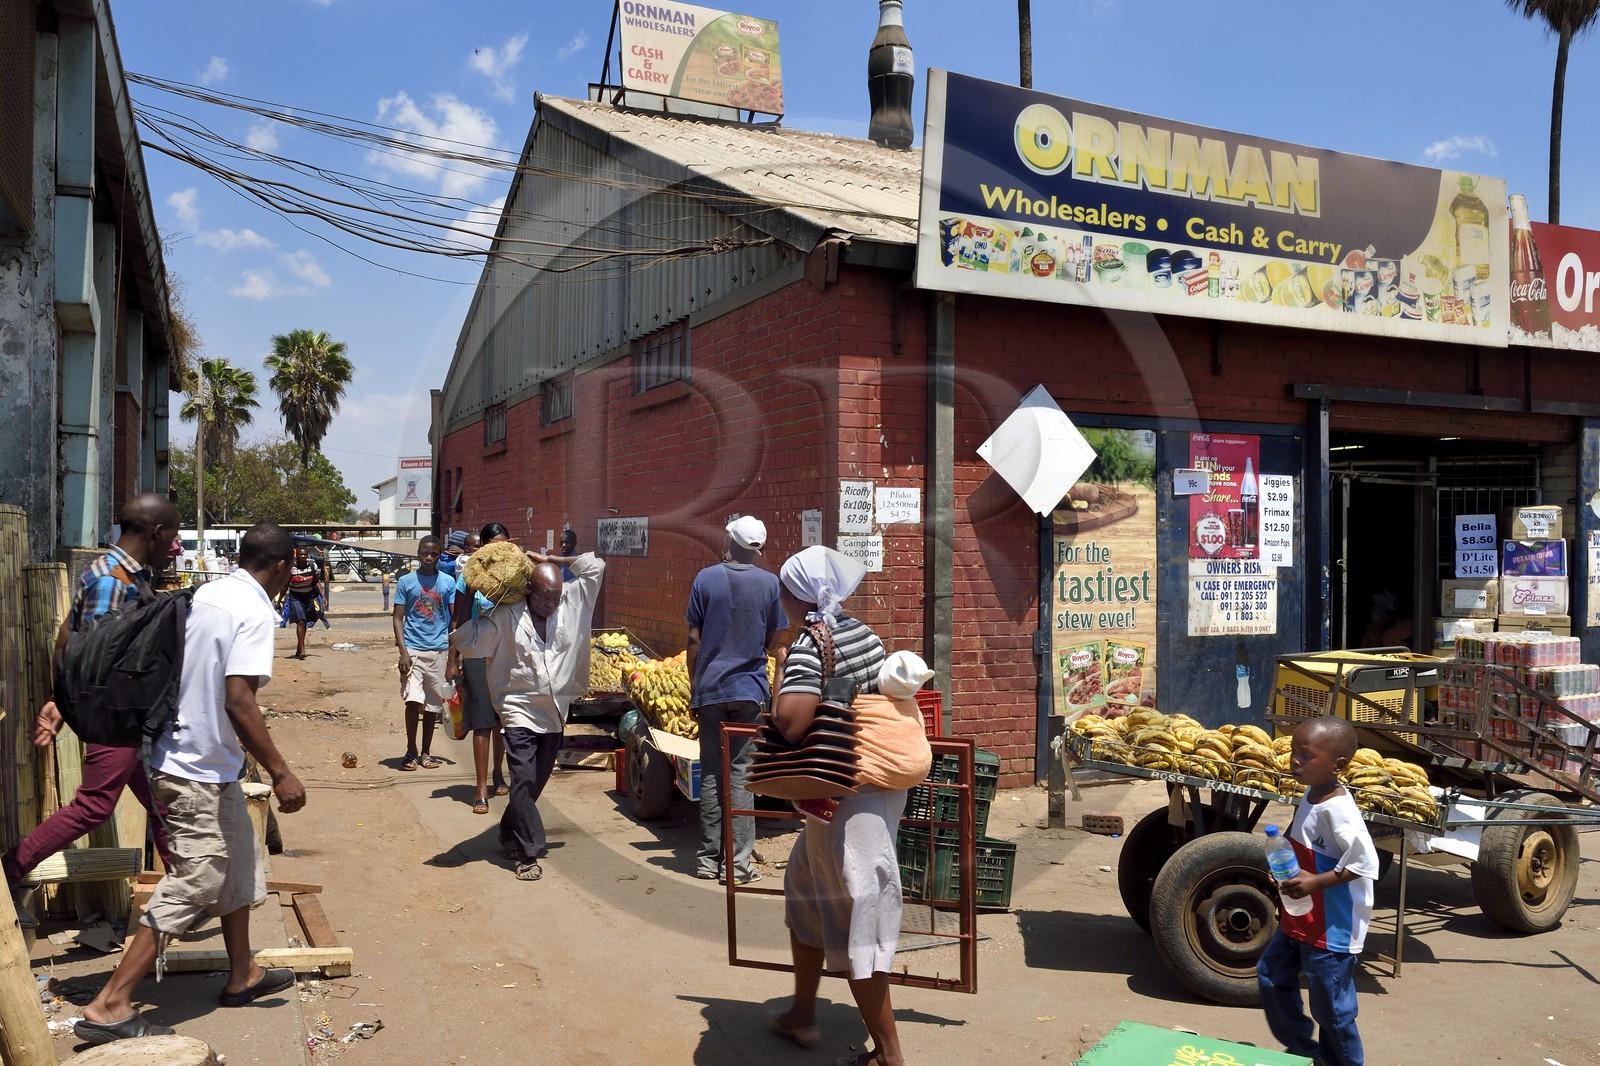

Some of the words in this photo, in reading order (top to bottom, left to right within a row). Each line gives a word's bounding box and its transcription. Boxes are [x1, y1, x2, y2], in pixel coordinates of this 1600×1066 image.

[624, 1, 695, 26] ORNMAN
[625, 17, 695, 37] WHOLESALERS
[740, 22, 760, 32] Royco
[631, 45, 663, 60] CASH
[644, 59, 653, 70] &
[628, 68, 669, 84] CARRY
[698, 77, 711, 86] the
[1014, 104, 1320, 218] ORNMAN
[980, 184, 1146, 232] Wholesalers
[1185, 218, 1245, 247] Cash
[1252, 228, 1270, 249] &
[1277, 231, 1342, 264] Carry
[1556, 252, 1600, 313] Or
[1510, 278, 1548, 303] Coca-Cola
[1194, 461, 1217, 471] FUN
[1208, 472, 1230, 481] ends
[1264, 478, 1290, 488] Jiggies
[844, 486, 871, 498] Ricoffy
[1267, 493, 1287, 502] $2.99
[843, 500, 871, 512] 6x100g
[1264, 508, 1290, 517] Frimax
[846, 514, 868, 524] $7.99
[1264, 523, 1290, 532] $12.50
[843, 540, 880, 548] Camphor
[1201, 534, 1224, 545] $1.00
[1462, 536, 1493, 545] $8.50
[1058, 542, 1080, 564] For
[1085, 541, 1110, 563] the
[1462, 553, 1494, 561] D'Lite
[1207, 562, 1241, 574] OWNERS
[1462, 565, 1494, 575] $14.50
[1058, 567, 1150, 603] tastiest
[1204, 581, 1220, 590] CASE
[1223, 581, 1231, 590] OF
[1234, 580, 1276, 590] EMERGENCY
[1201, 592, 1218, 600] CALL:
[1220, 592, 1232, 600] 091
[1235, 592, 1238, 600] 2
[1241, 592, 1253, 600] 205
[1255, 592, 1268, 600] 522
[1513, 590, 1555, 604] Frimax
[1220, 602, 1232, 610] 091
[1235, 602, 1238, 610] 2
[1255, 602, 1267, 610] 300
[1057, 610, 1093, 630] stew
[1098, 606, 1136, 629] ever!
[1241, 612, 1253, 621] 803
[1205, 780, 1262, 799] RAMBA
